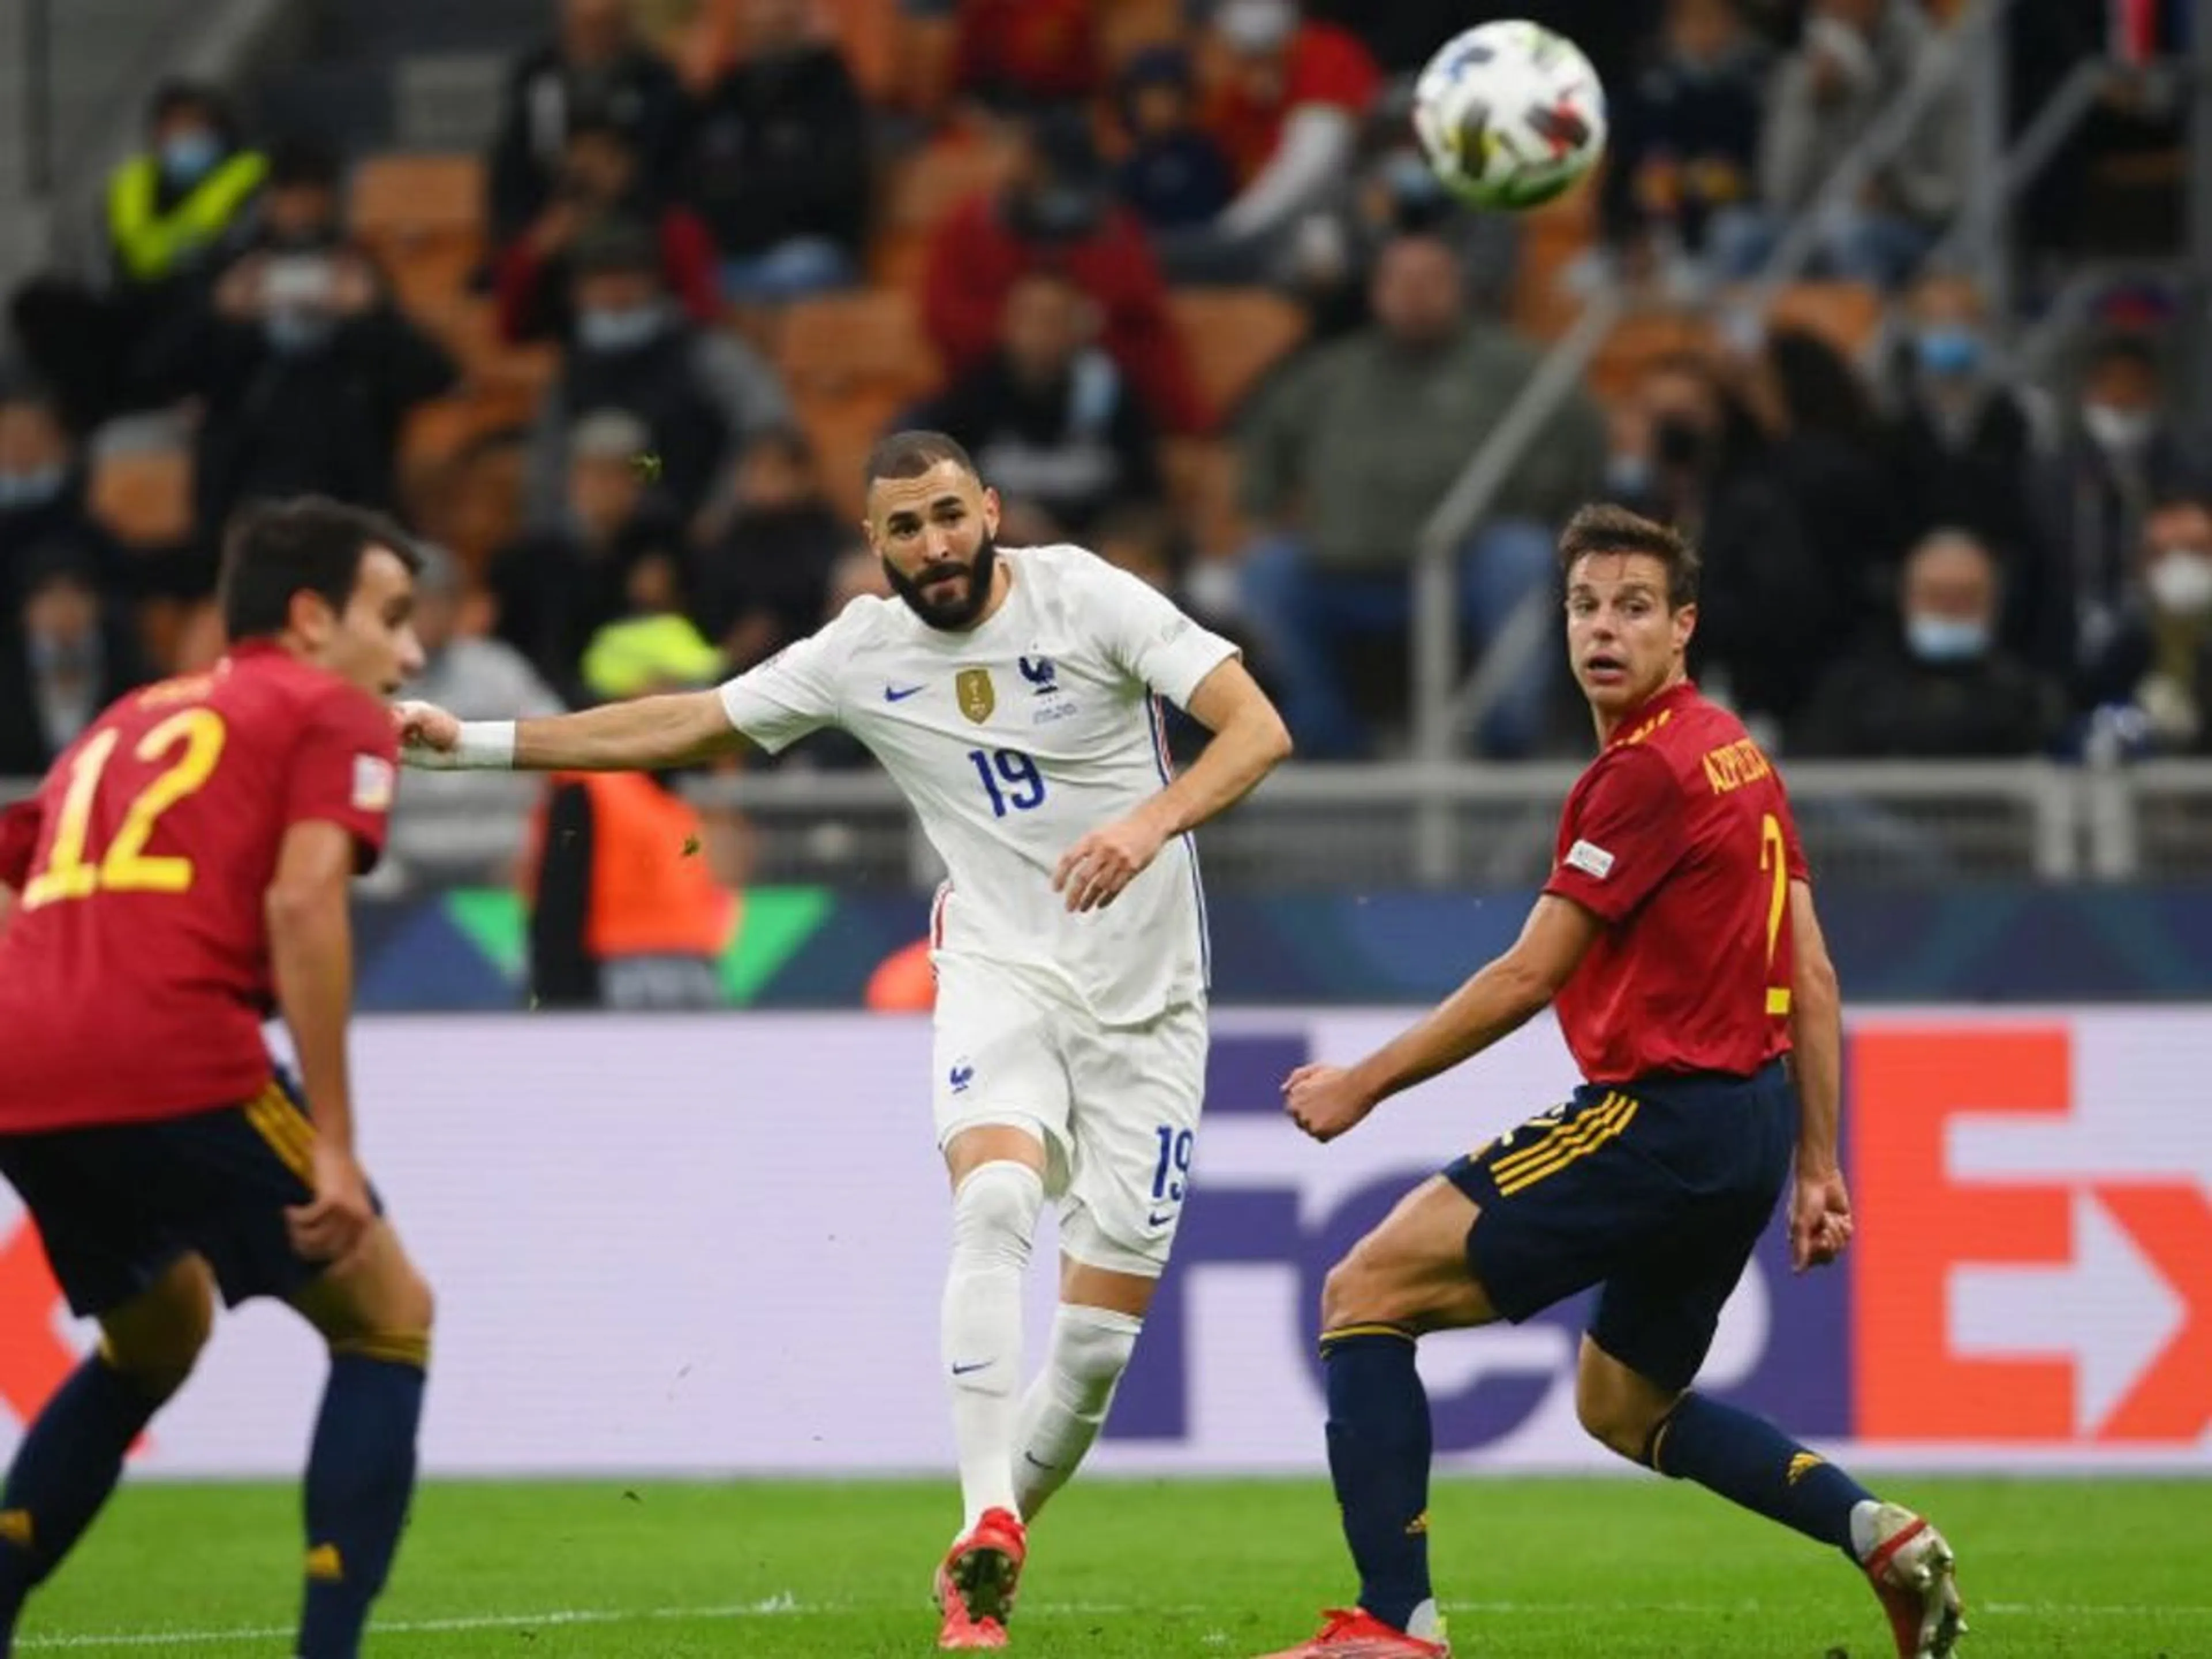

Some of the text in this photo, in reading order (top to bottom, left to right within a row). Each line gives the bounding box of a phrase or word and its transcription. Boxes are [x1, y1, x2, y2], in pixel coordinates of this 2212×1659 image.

[21, 707, 226, 911] 12
[968, 748, 1045, 817] 19
[1760, 813, 1791, 1014] 2
[1152, 1125, 1194, 1202] 19
